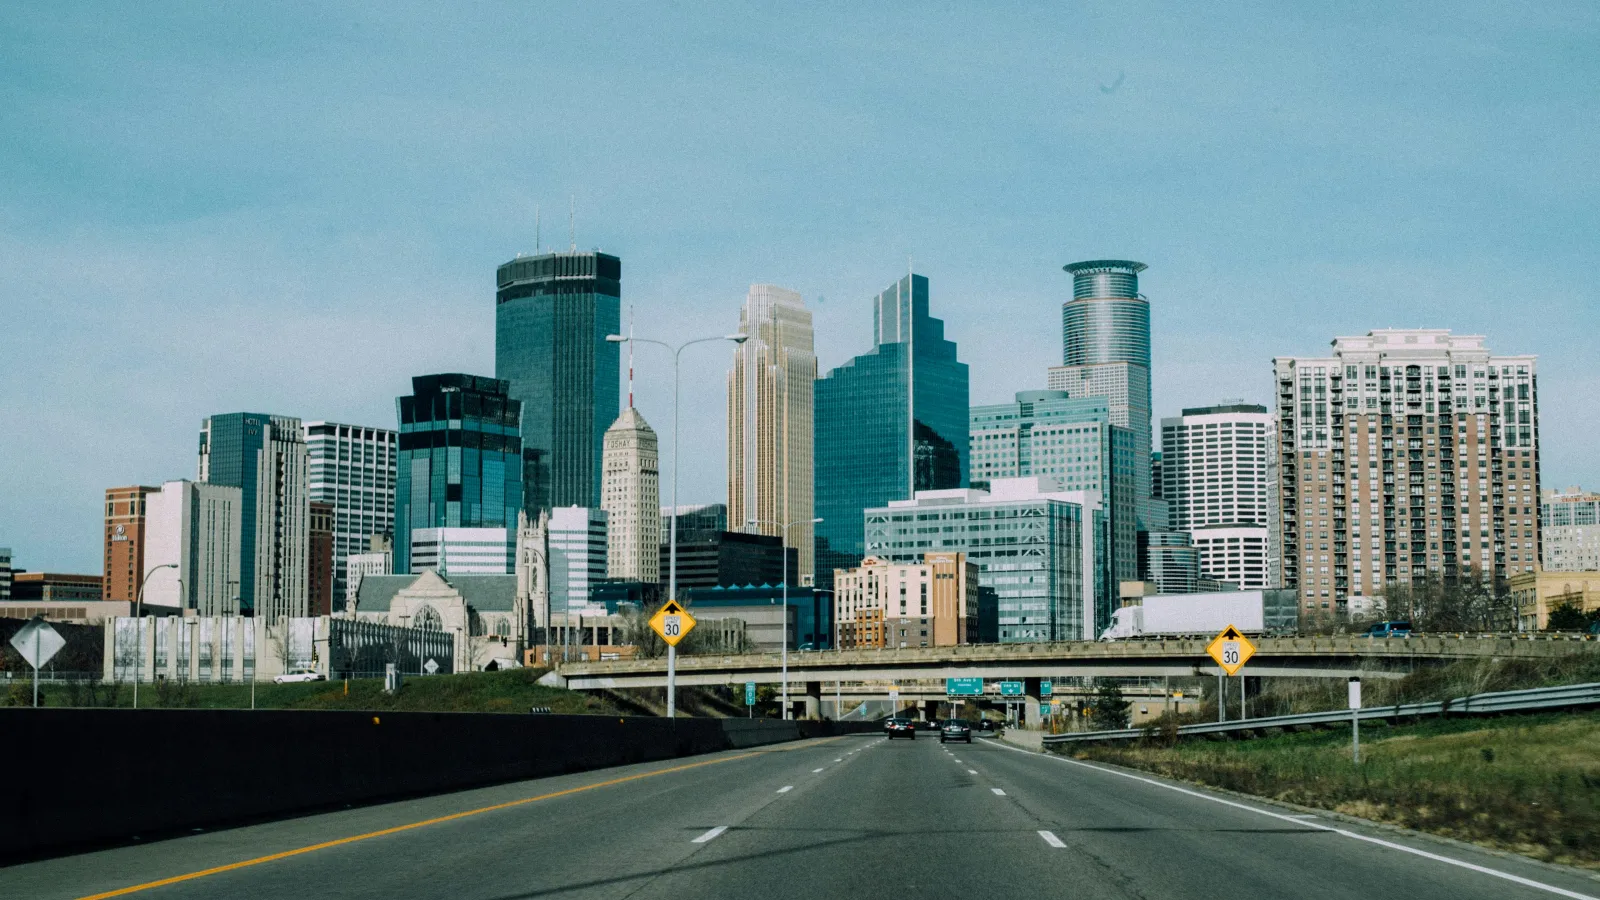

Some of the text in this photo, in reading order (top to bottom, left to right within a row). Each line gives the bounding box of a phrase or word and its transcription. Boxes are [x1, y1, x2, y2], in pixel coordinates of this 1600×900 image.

[607, 439, 630, 448] FOSHAY
[665, 624, 679, 636] 30
[1224, 651, 1239, 664] 30
